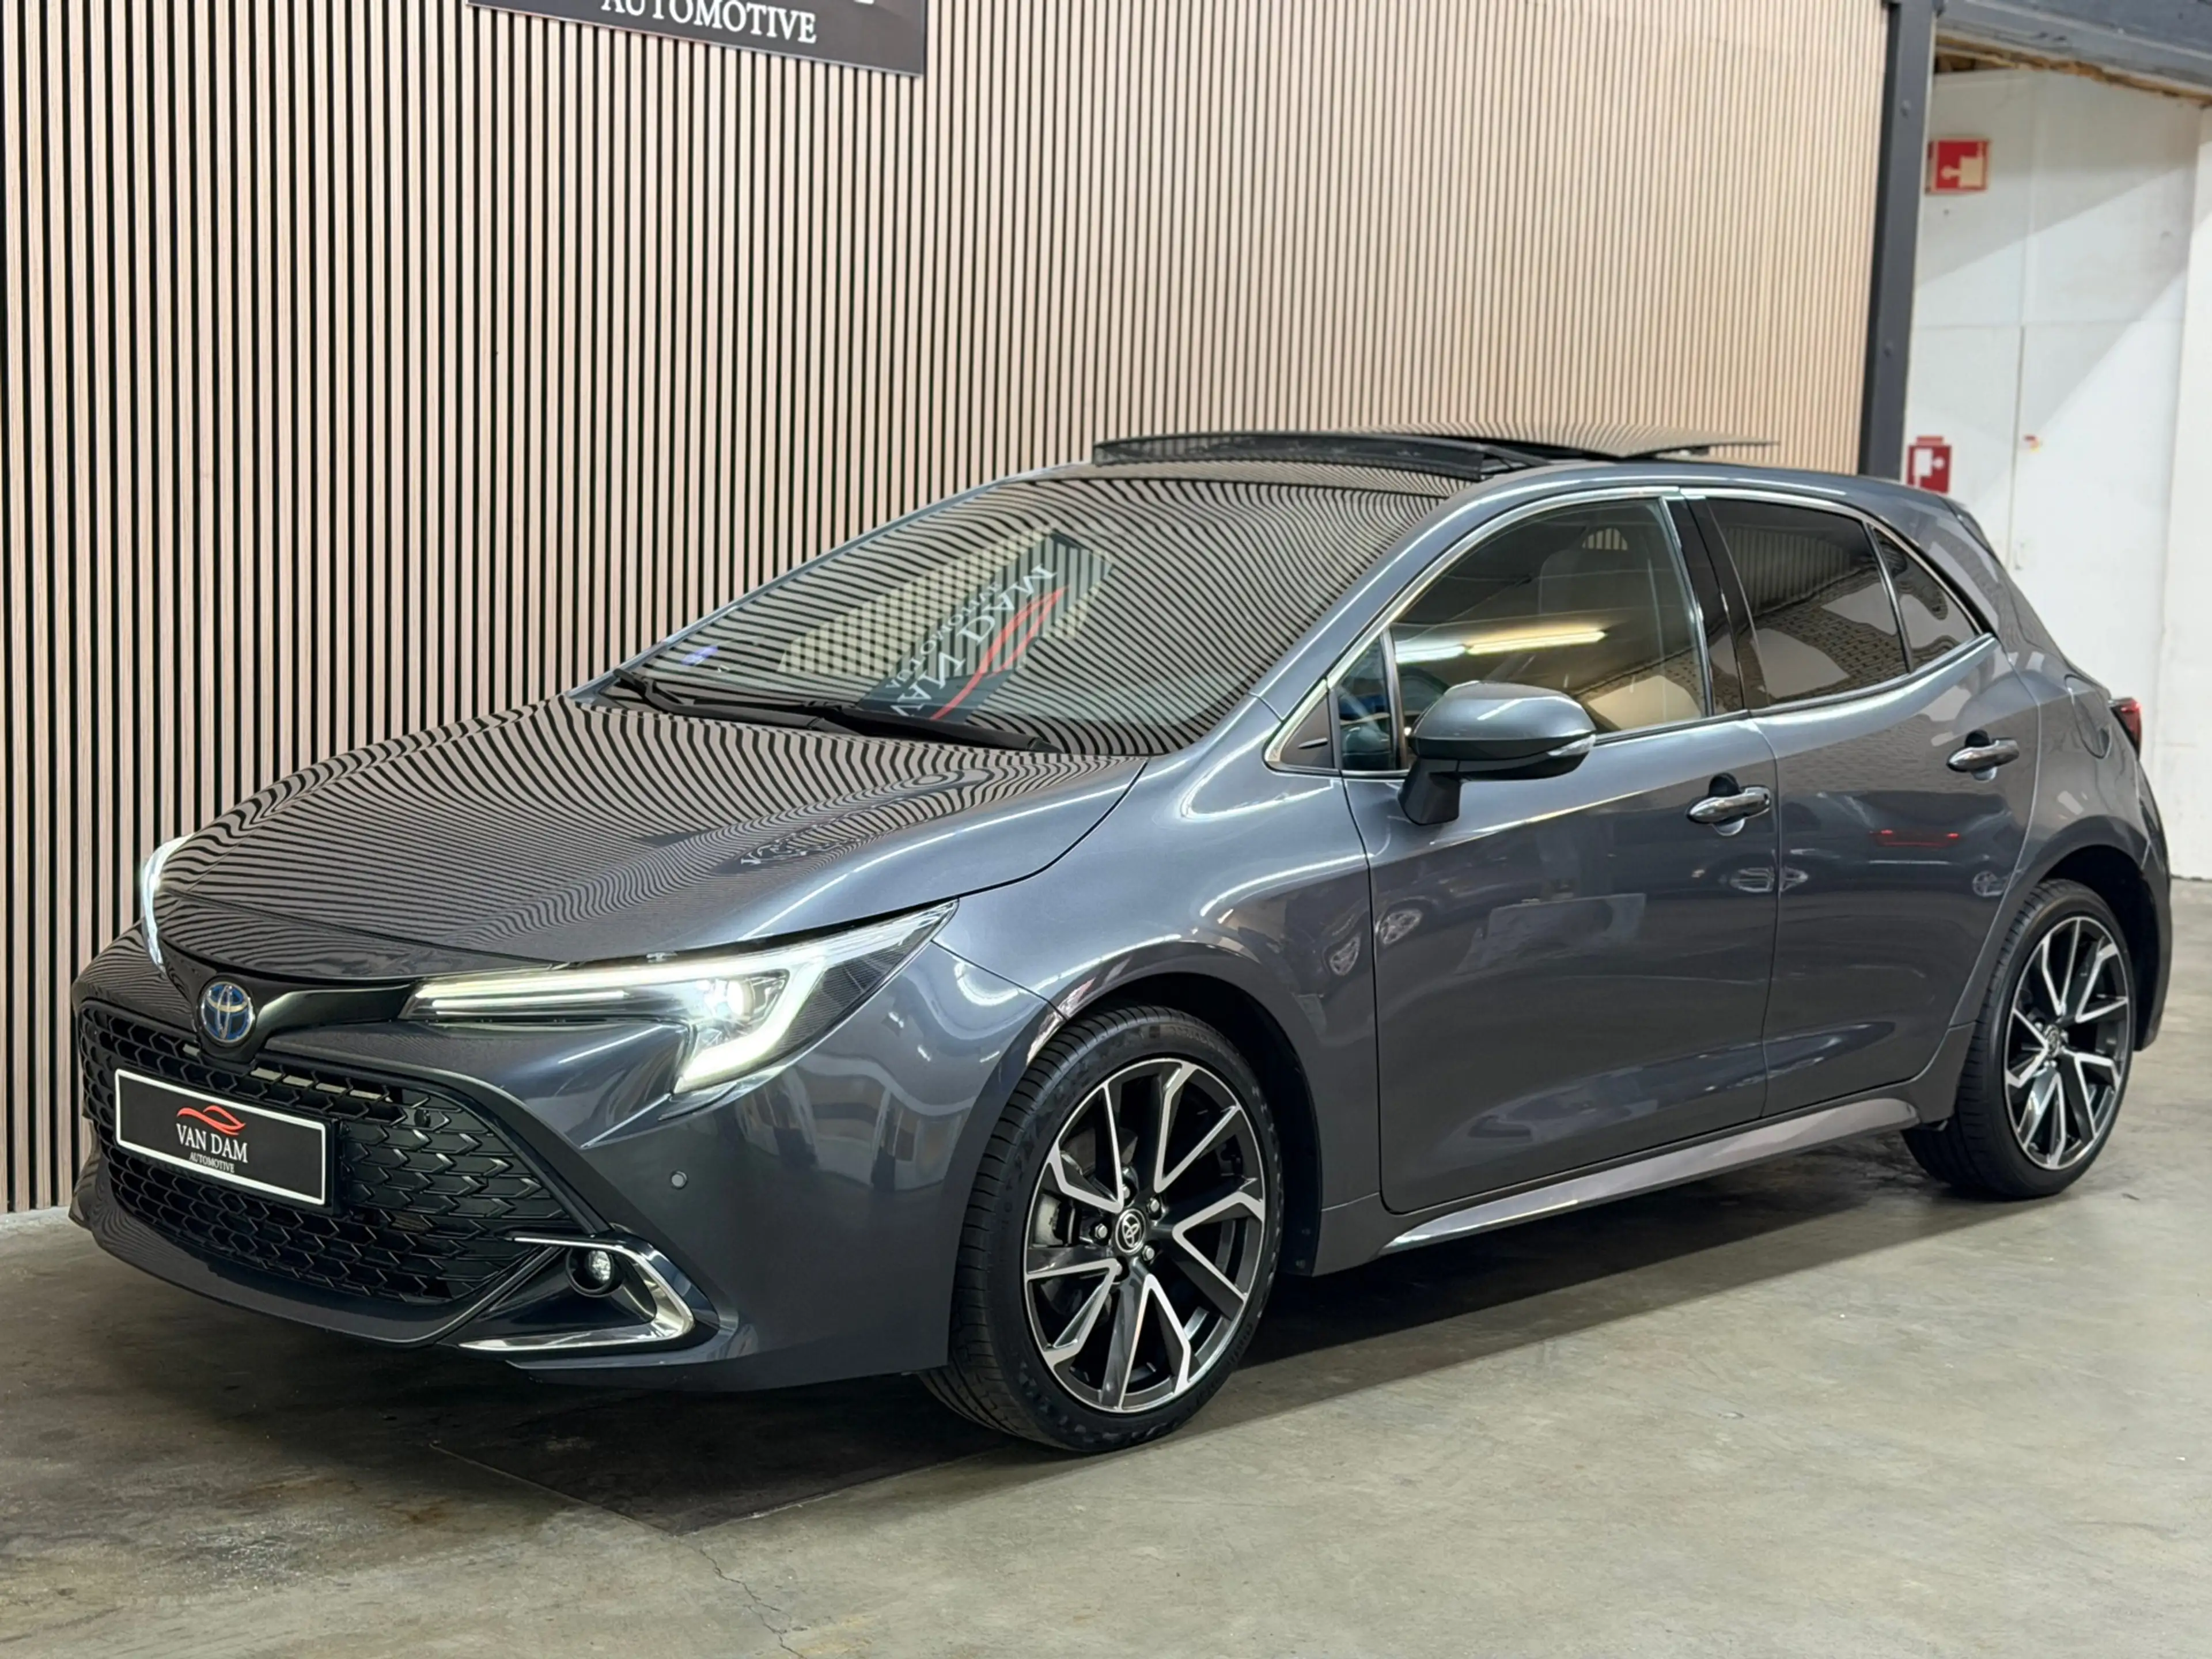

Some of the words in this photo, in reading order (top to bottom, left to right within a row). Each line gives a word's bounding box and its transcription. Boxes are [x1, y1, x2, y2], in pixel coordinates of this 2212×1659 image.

[176, 1123, 207, 1152] VAN
[210, 1132, 248, 1163] DAM
[189, 1152, 235, 1173] AUTOMOTIVE
